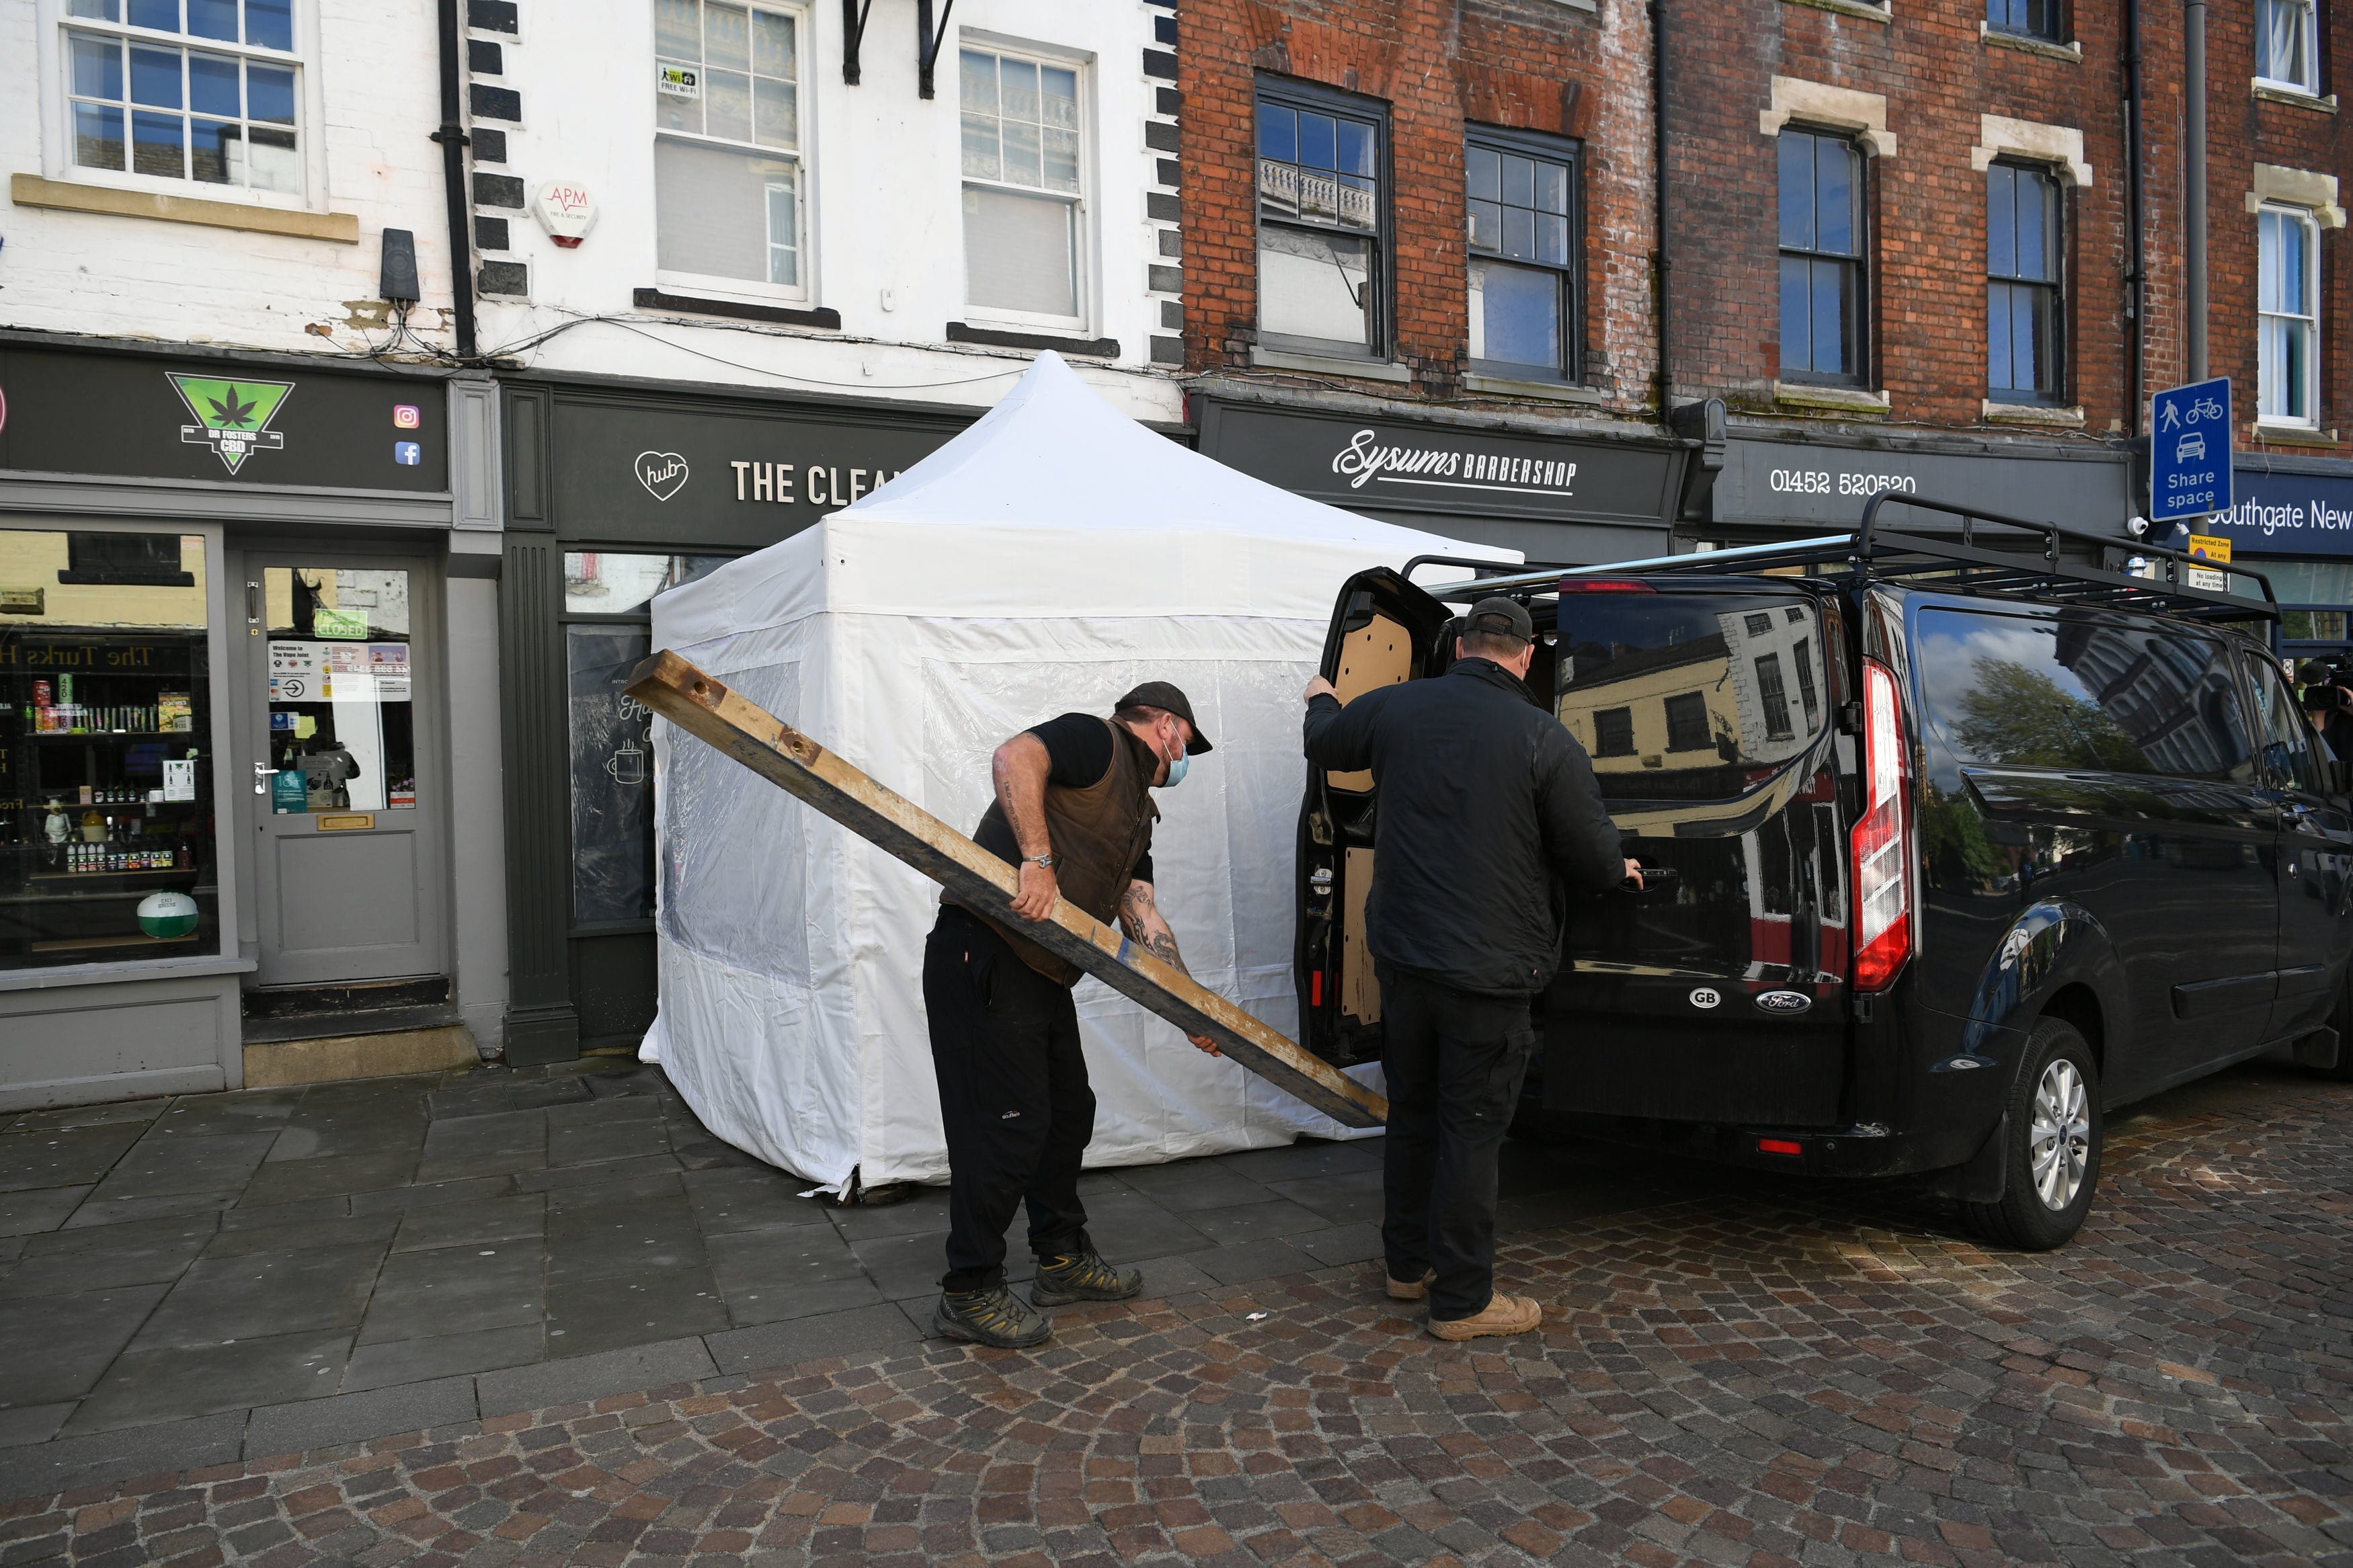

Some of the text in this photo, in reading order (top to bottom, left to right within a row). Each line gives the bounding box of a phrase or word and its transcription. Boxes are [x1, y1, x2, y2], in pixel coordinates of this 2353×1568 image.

[662, 83, 696, 95] FREE Wi-Fi
[549, 187, 588, 207] APM
[208, 429, 256, 441] DR FOSTERS
[221, 440, 245, 453] CBD
[1332, 429, 1577, 489] Sysums BARBERSHOP
[647, 459, 678, 486] hub
[2167, 472, 2215, 489] Share
[731, 460, 901, 505] THE CLE
[1770, 469, 1916, 496] 01452 520520
[2167, 490, 2215, 509] space
[2311, 499, 2353, 530] New
[2192, 538, 2217, 546] Restricted
[2205, 573, 2223, 581] loading
[319, 624, 363, 636] CLOSED
[1694, 992, 1716, 1003] GB
[1767, 994, 1799, 1009] Ford
